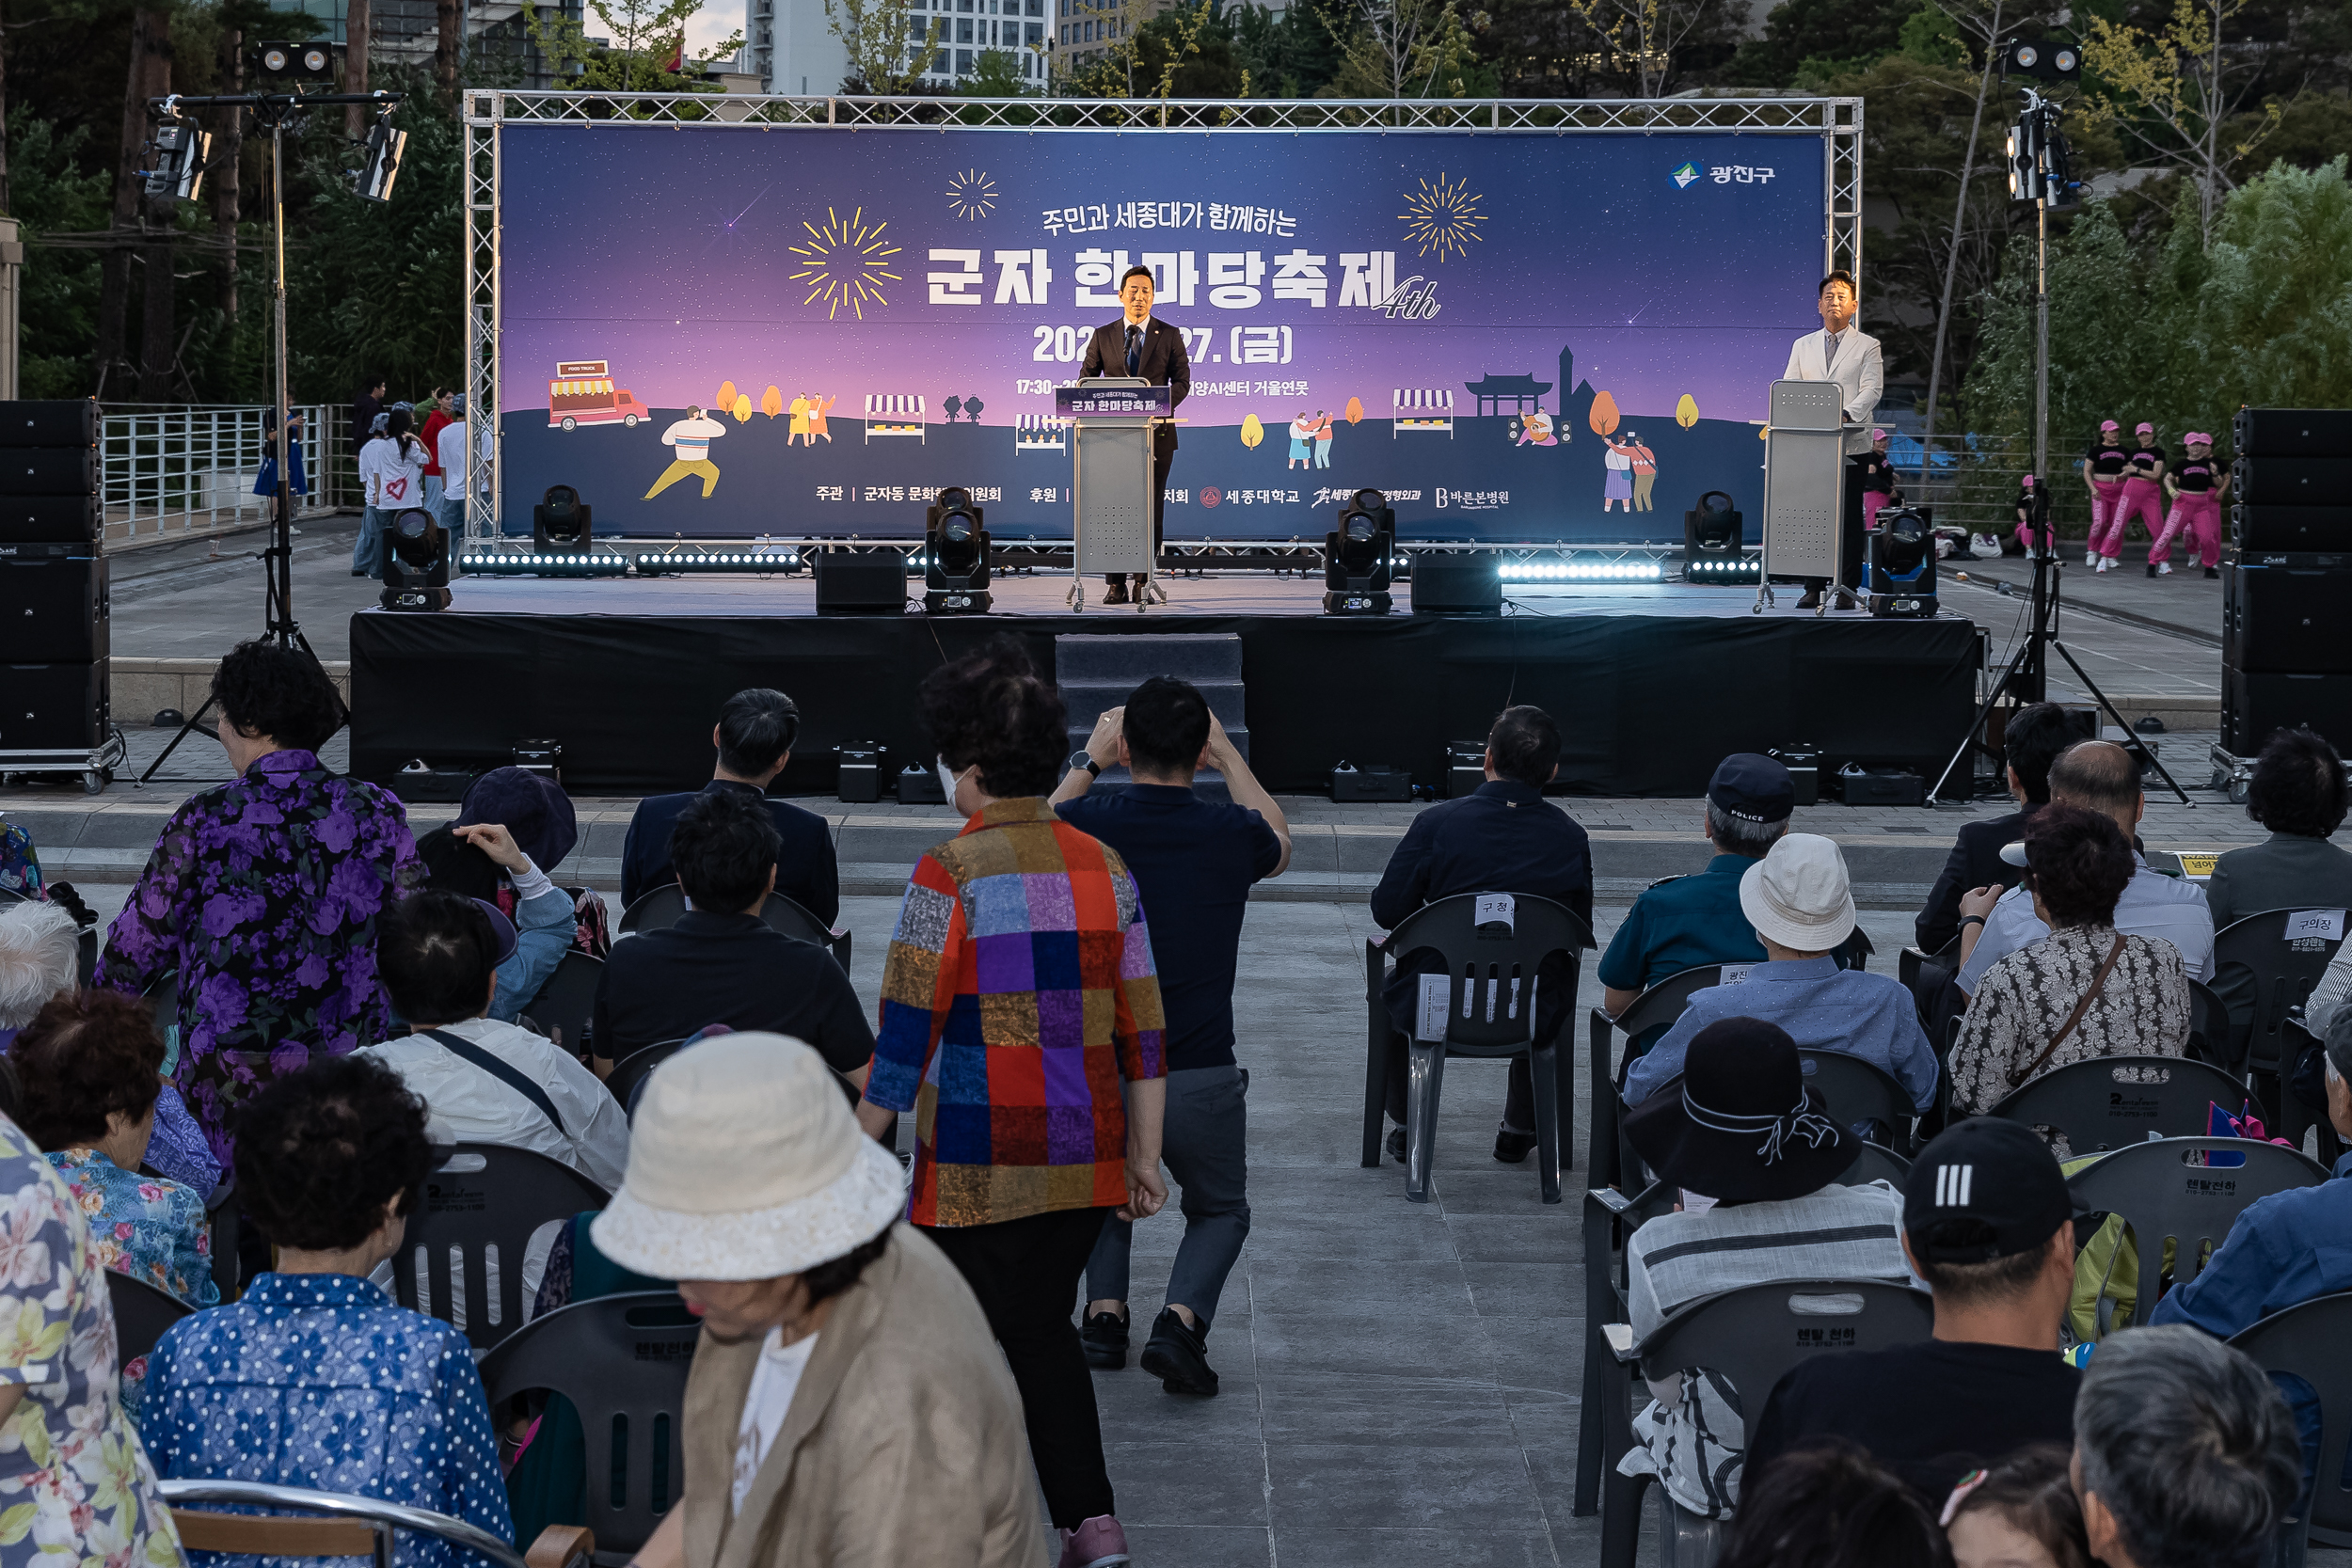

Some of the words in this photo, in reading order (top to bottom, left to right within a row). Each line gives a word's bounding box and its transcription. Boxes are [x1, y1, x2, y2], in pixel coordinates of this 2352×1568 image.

[1708, 165, 1776, 184] 광진구
[1041, 204, 1109, 237] 주민과
[1112, 200, 1204, 230] 세종대가
[1207, 200, 1298, 238] 함께하는
[927, 247, 1053, 306] 군자
[1073, 246, 1397, 309] 한마당축제
[1370, 274, 1442, 321] 4th
[1229, 325, 1293, 364] (금)
[1253, 380, 1310, 397] 거울연못
[1072, 400, 1095, 412] 군자
[1098, 400, 1156, 412] 한마당축제
[816, 485, 844, 501] 주관
[864, 485, 905, 502] 군자동
[1029, 487, 1057, 503] 후원
[1225, 488, 1300, 505] 세종대학교
[1450, 490, 1510, 505] 바른본병원
[1731, 809, 1764, 822] POLICE
[2298, 918, 2332, 931] 구의장
[2186, 1179, 2236, 1191] 렌탈천하
[428, 1203, 485, 1212] 010-2753-1100
[1797, 1327, 1823, 1340] 렌탈
[1829, 1327, 1855, 1340] 천하
